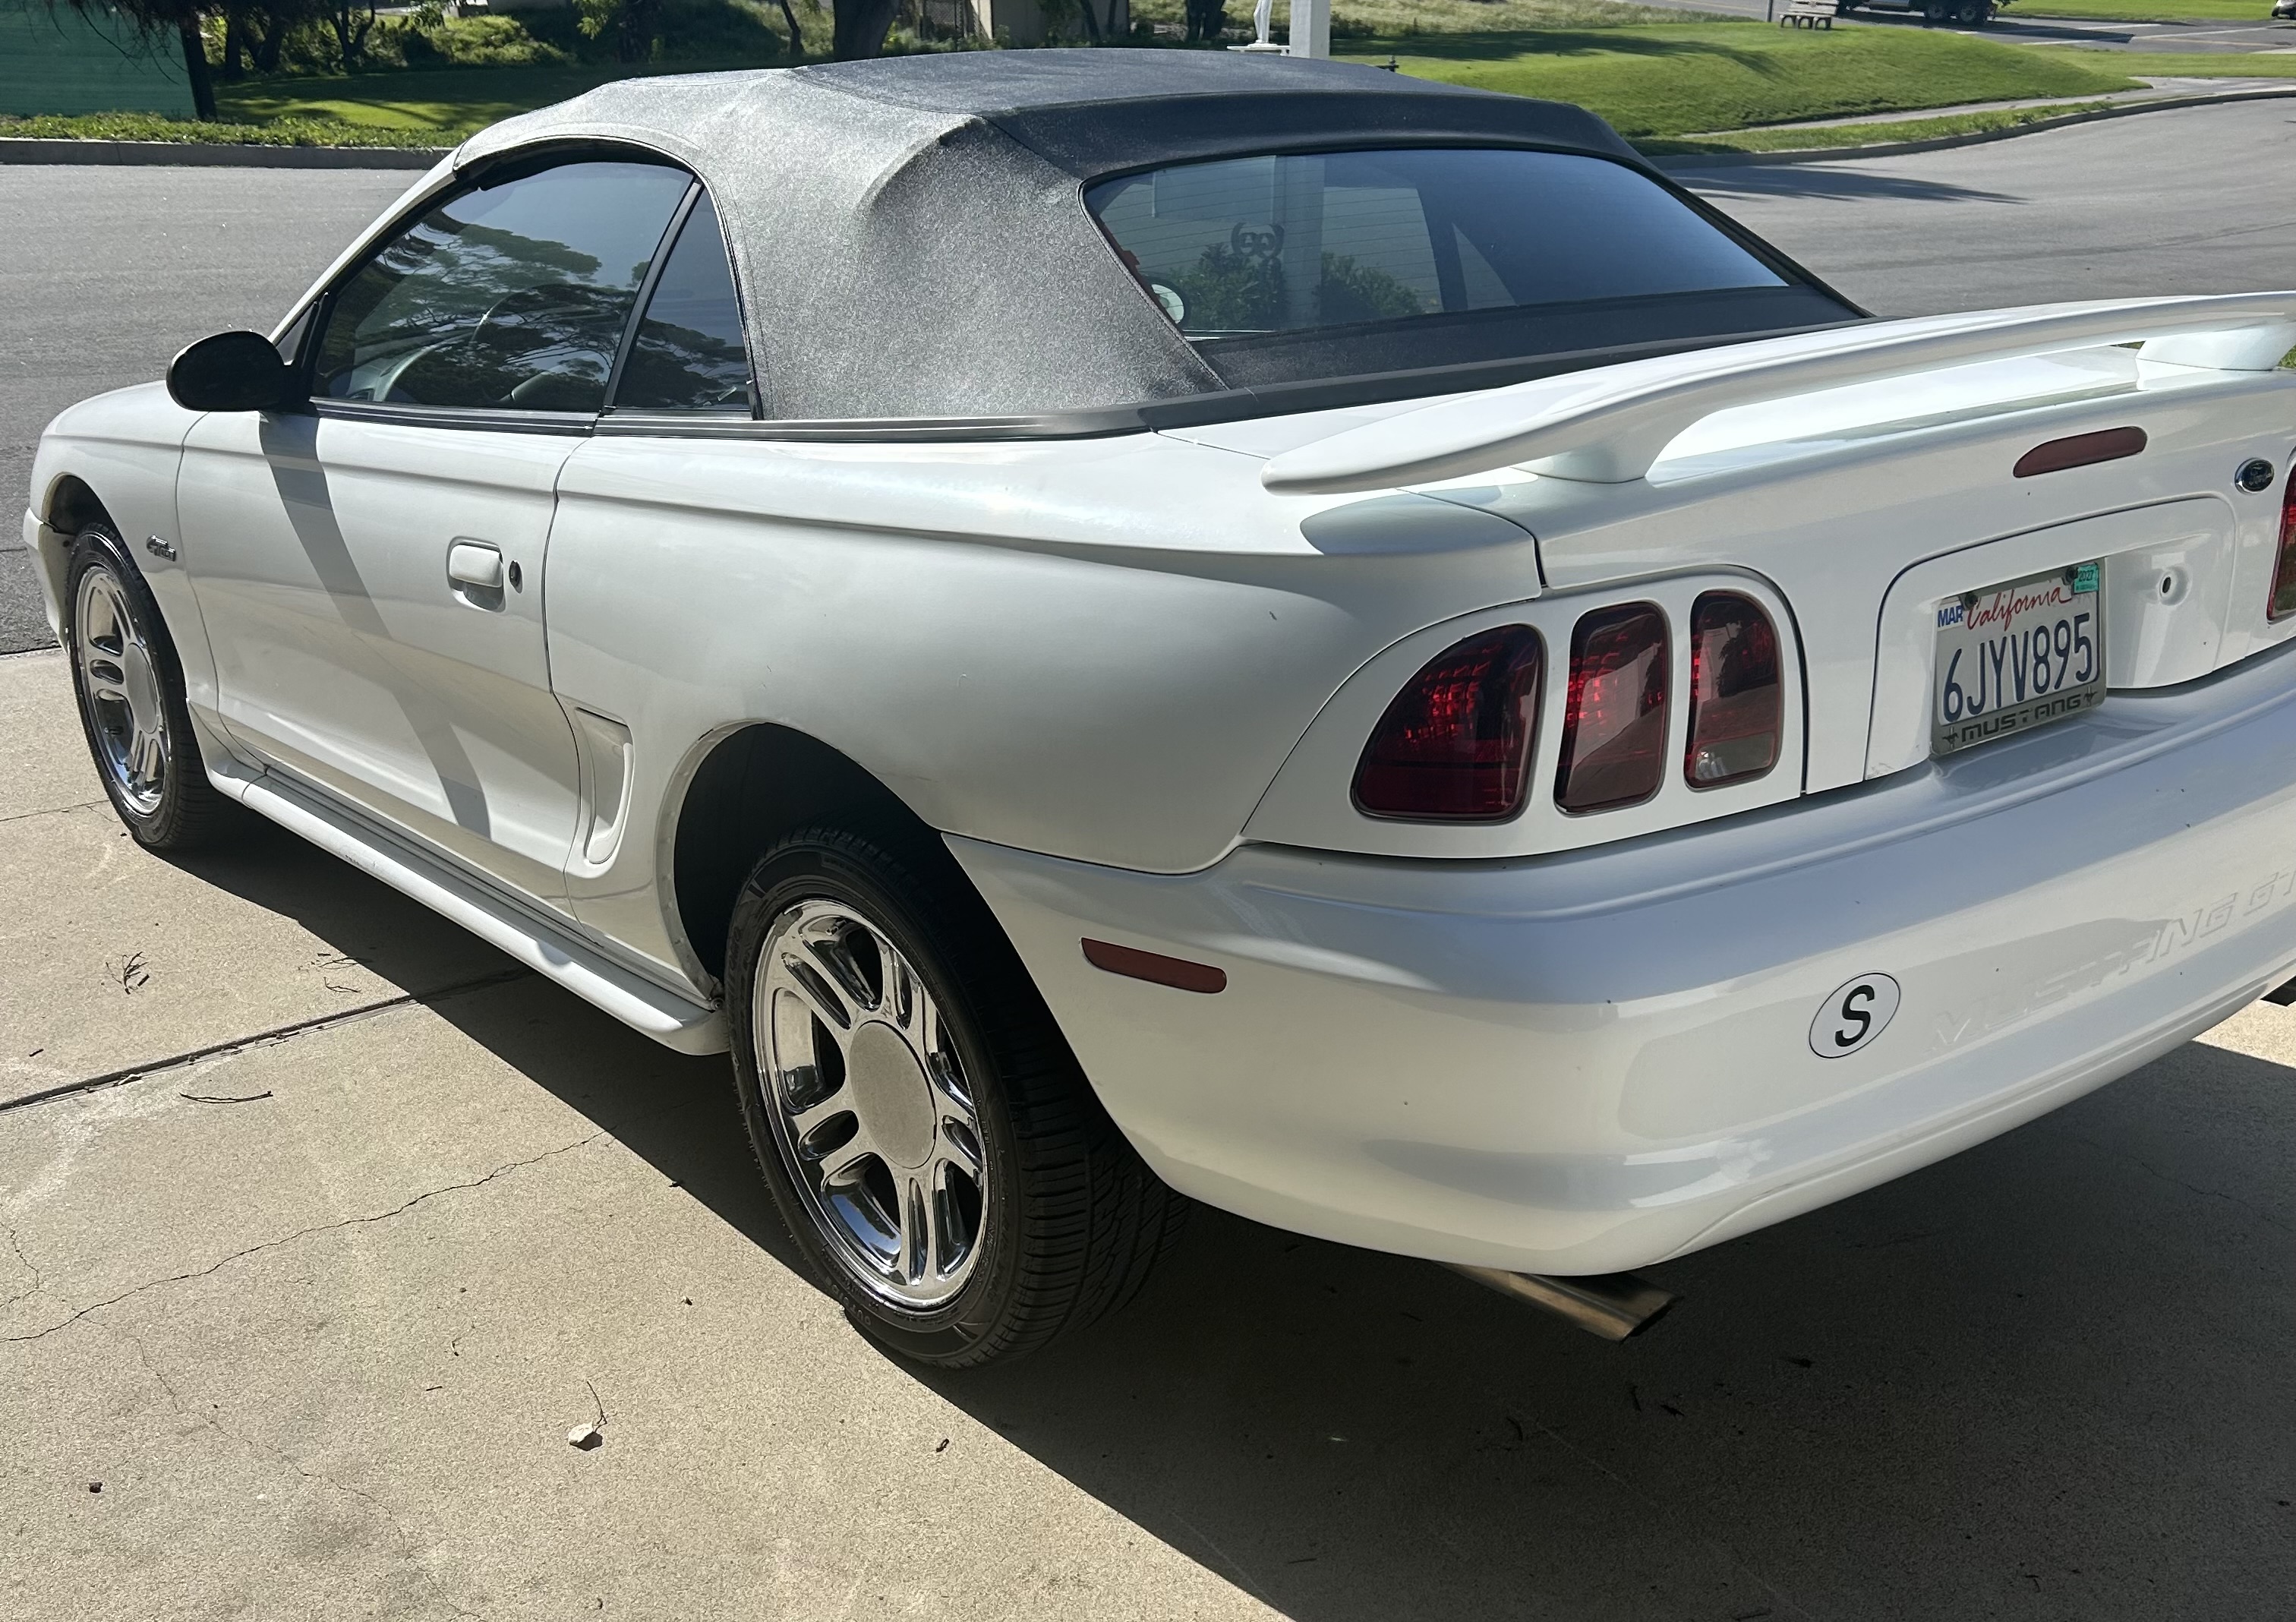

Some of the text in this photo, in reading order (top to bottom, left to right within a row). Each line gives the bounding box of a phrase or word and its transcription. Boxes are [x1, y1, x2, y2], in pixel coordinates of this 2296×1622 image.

[1938, 605, 1963, 628] MAR
[1966, 586, 2072, 631] California
[1943, 612, 2092, 722] 6JYV895
[1961, 693, 2082, 743] MUSTANG
[1835, 985, 1875, 1048] S
